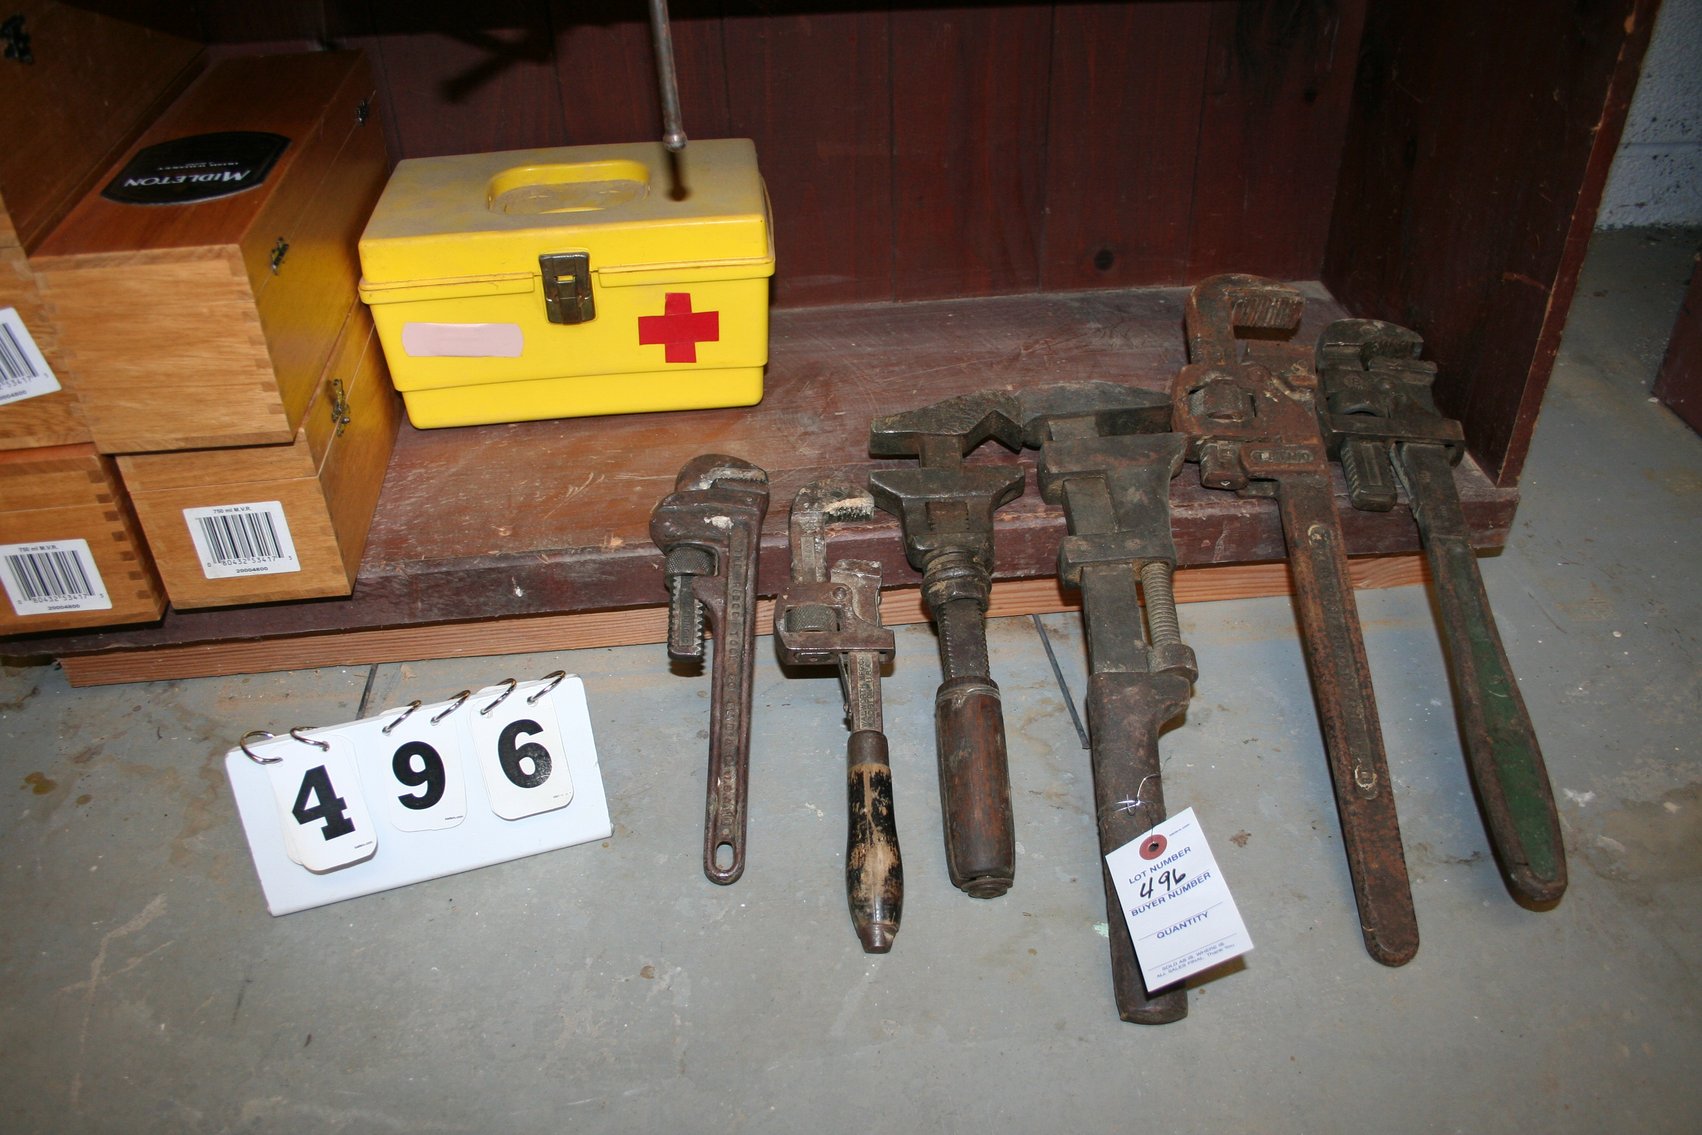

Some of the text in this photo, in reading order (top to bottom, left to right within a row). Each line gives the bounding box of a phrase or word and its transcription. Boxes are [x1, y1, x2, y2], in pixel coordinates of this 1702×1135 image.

[124, 170, 251, 187] MIDLETON
[222, 558, 248, 567] 80432
[252, 555, 276, 564] 53417
[1128, 846, 1191, 884] LOT NUMBER
[1131, 871, 1211, 917] BUYER NUMBER
[1139, 868, 1186, 899] 496
[1156, 911, 1209, 940] QUANTITY
